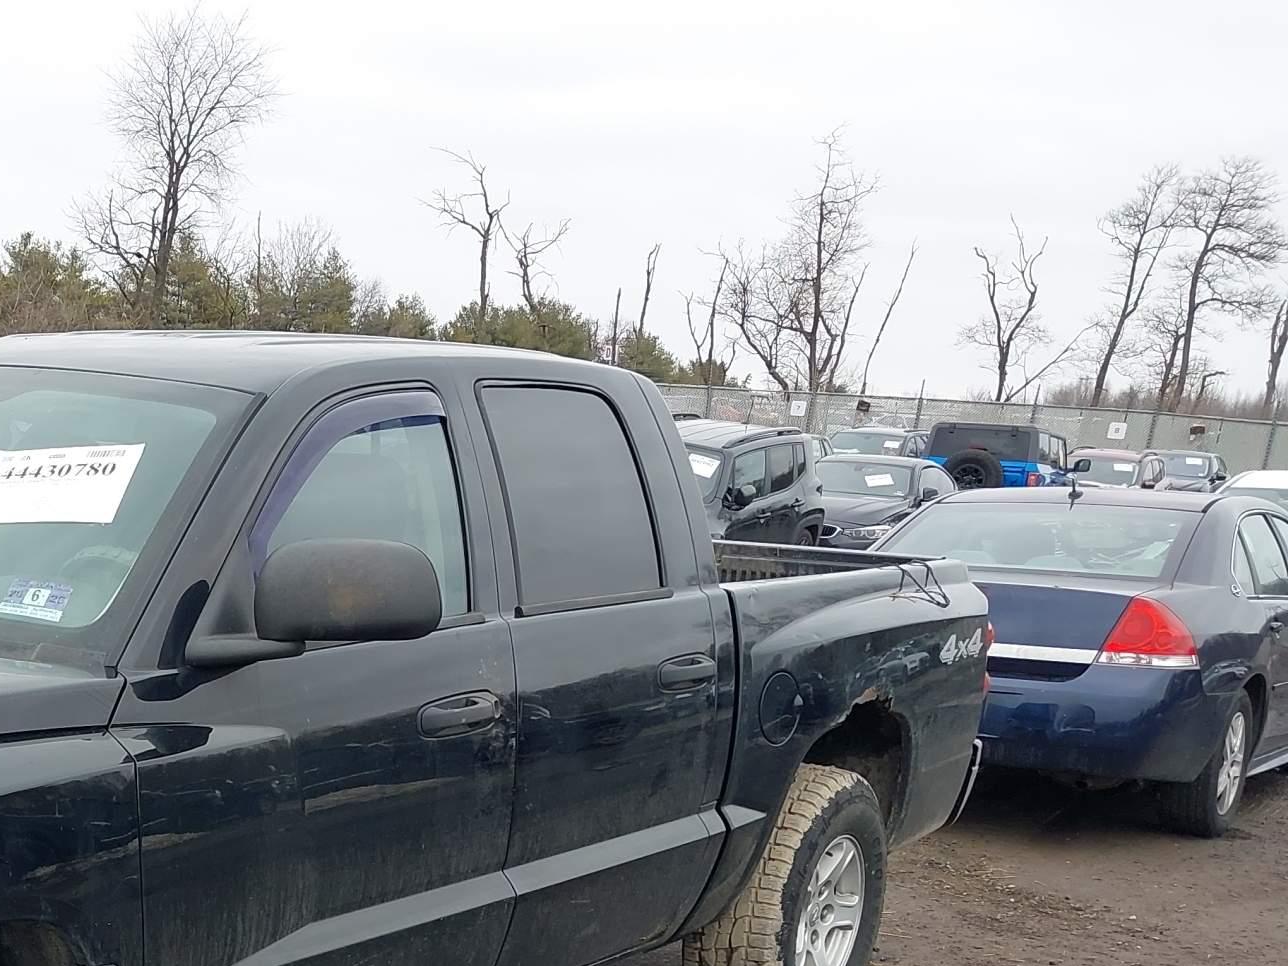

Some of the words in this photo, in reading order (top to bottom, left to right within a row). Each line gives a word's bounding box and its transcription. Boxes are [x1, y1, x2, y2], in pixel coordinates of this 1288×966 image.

[1, 462, 117, 480] 44430780
[31, 589, 42, 602] 6
[939, 628, 983, 665] 4x4
